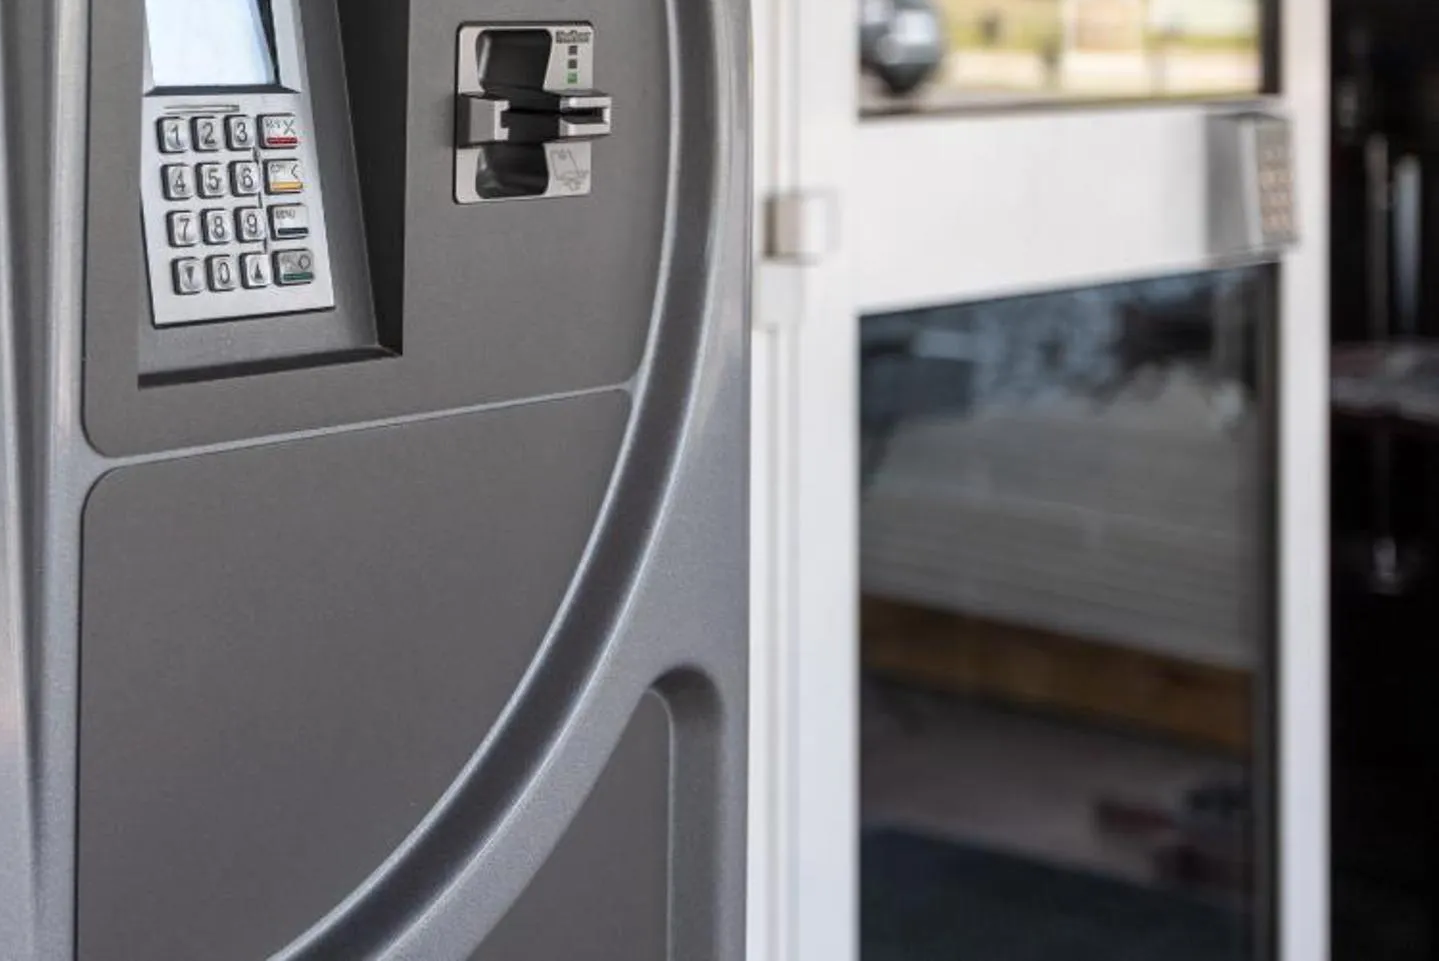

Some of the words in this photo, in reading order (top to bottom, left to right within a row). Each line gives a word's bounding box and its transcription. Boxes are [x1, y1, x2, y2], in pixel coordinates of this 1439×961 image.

[171, 124, 180, 144] 1
[202, 123, 215, 145] 2
[236, 122, 248, 143] 3
[175, 171, 185, 192] 4
[208, 170, 220, 191] 5
[242, 168, 253, 188] 6
[180, 218, 190, 241] 7
[213, 217, 225, 239] 8
[247, 214, 258, 235] 9
[219, 262, 230, 284] 0
